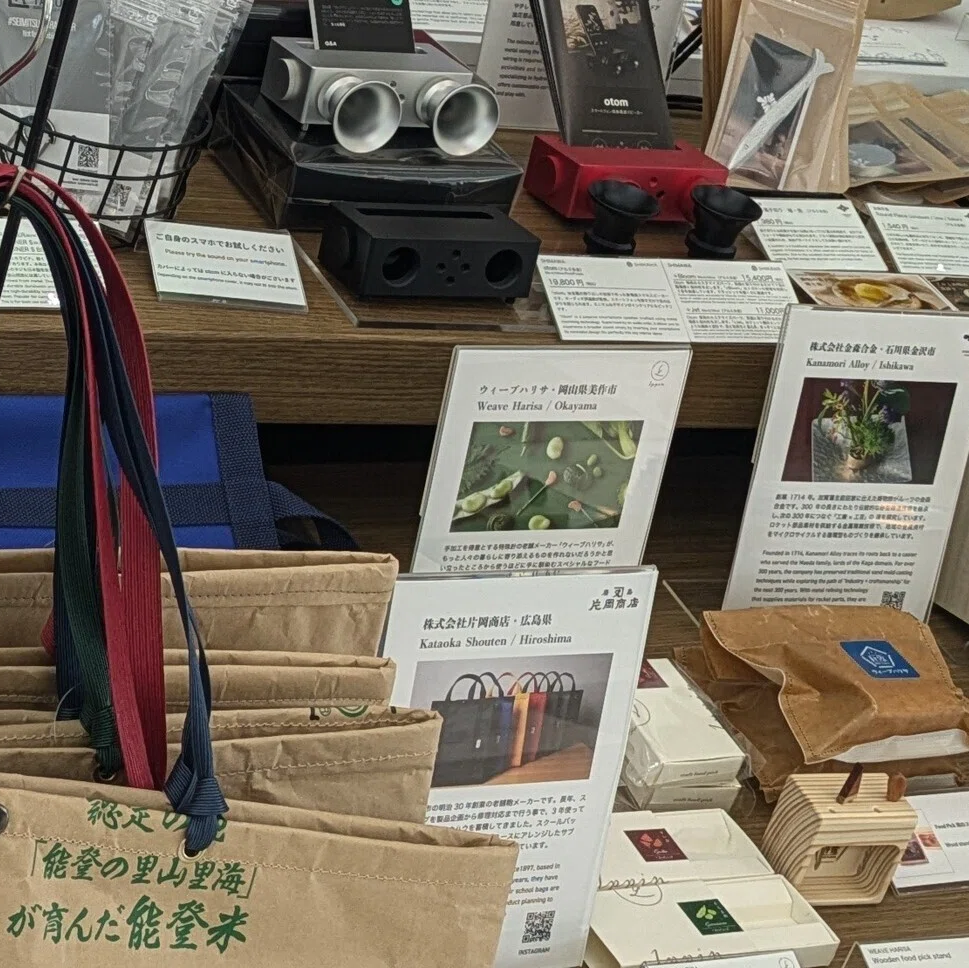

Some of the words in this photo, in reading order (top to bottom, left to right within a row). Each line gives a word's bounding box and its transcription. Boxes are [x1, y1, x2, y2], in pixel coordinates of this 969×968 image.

[603, 97, 629, 107] otom
[165, 248, 185, 256] Please
[250, 258, 287, 267] smartphone.
[806, 358, 846, 368] Kanamori
[849, 359, 869, 371] Alloy
[879, 361, 914, 371] Ishikawa
[479, 383, 617, 396] ウィーブハリサ・岡山県美作市
[477, 401, 508, 411] Weave
[512, 401, 543, 411] Harisa
[554, 400, 598, 413] Okayama
[801, 503, 813, 511] 300
[423, 613, 553, 630] 株式会社片岡商店・広島県
[419, 637, 461, 649] Kataoka
[465, 636, 507, 647] Shouten
[519, 633, 572, 644] Hiroshima
[454, 802, 464, 810] 30
[31, 839, 257, 899] 「能登の里山里海」
[521, 897, 546, 905] planning
[6, 895, 249, 953] が育んだ能登米
[518, 947, 550, 956] INSTAGRAM
[872, 956, 900, 964] Wooden
